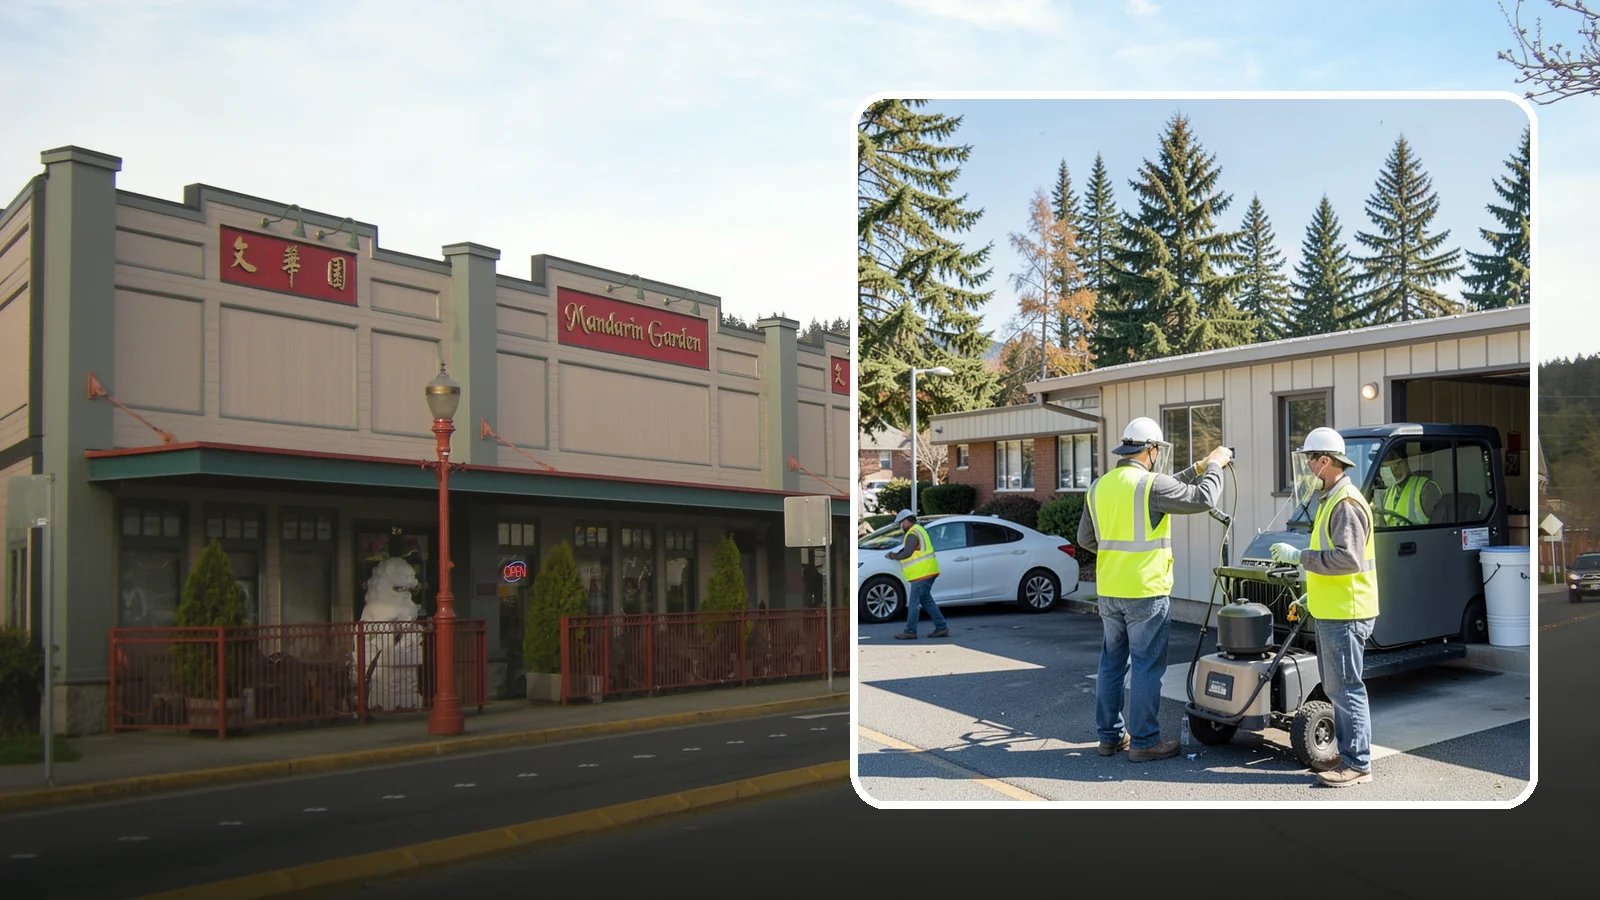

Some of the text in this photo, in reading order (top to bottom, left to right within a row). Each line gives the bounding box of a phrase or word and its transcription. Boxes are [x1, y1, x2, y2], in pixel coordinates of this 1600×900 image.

[230, 235, 346, 291] 文華園
[564, 302, 701, 352] Mandarin Garden
[503, 565, 527, 578] OPEN
